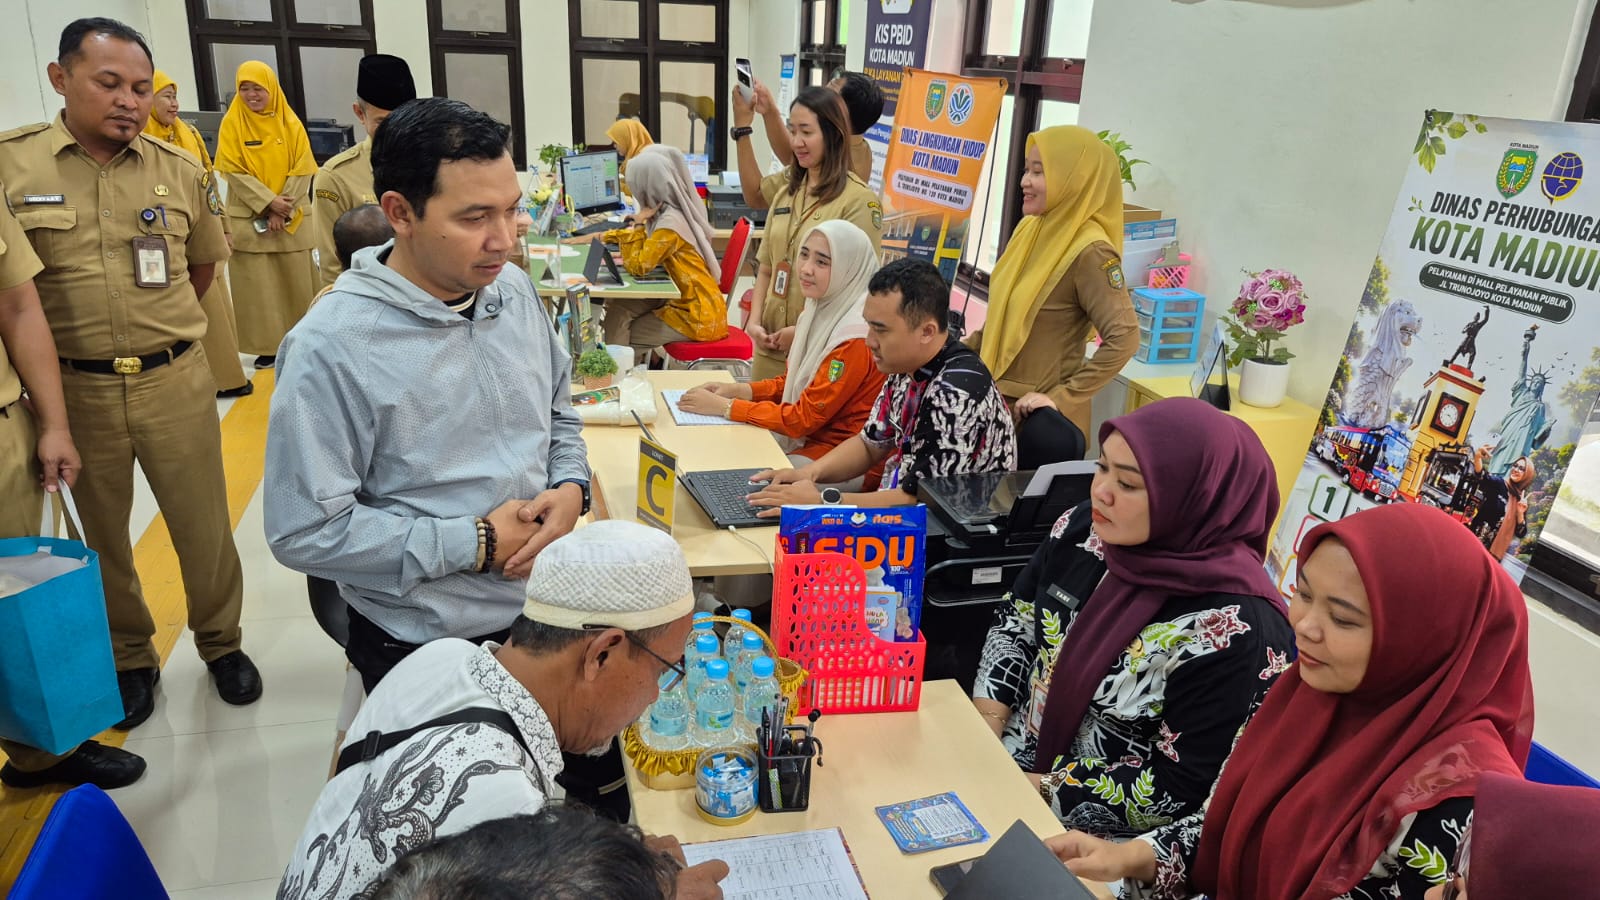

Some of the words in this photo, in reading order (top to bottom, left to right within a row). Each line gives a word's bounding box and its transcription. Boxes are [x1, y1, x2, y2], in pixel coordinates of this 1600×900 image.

[875, 23, 890, 44] KIS
[891, 24, 913, 45] PBID
[869, 47, 887, 64] KOTA
[887, 49, 915, 67] MADIUN
[901, 128, 918, 145] DINAS
[919, 132, 961, 154] LINGKUNGAN
[961, 139, 986, 159] HIDUP
[911, 150, 931, 168] KOTA
[930, 154, 960, 175] MADIUN
[1430, 191, 1482, 221] DINAS
[1409, 215, 1485, 264] KOTA
[1427, 265, 1467, 283] PELAYANAN
[1475, 278, 1494, 291] MALL
[1494, 281, 1540, 301] PELAYANAN
[1539, 294, 1569, 309] PUBLIK
[1438, 279, 1448, 289] JL
[1448, 282, 1491, 300] TRUNOJOYO
[1491, 292, 1512, 306] KOTA
[1511, 298, 1543, 314] MADIUN
[646, 465, 667, 516] C
[1323, 487, 1336, 514] 1
